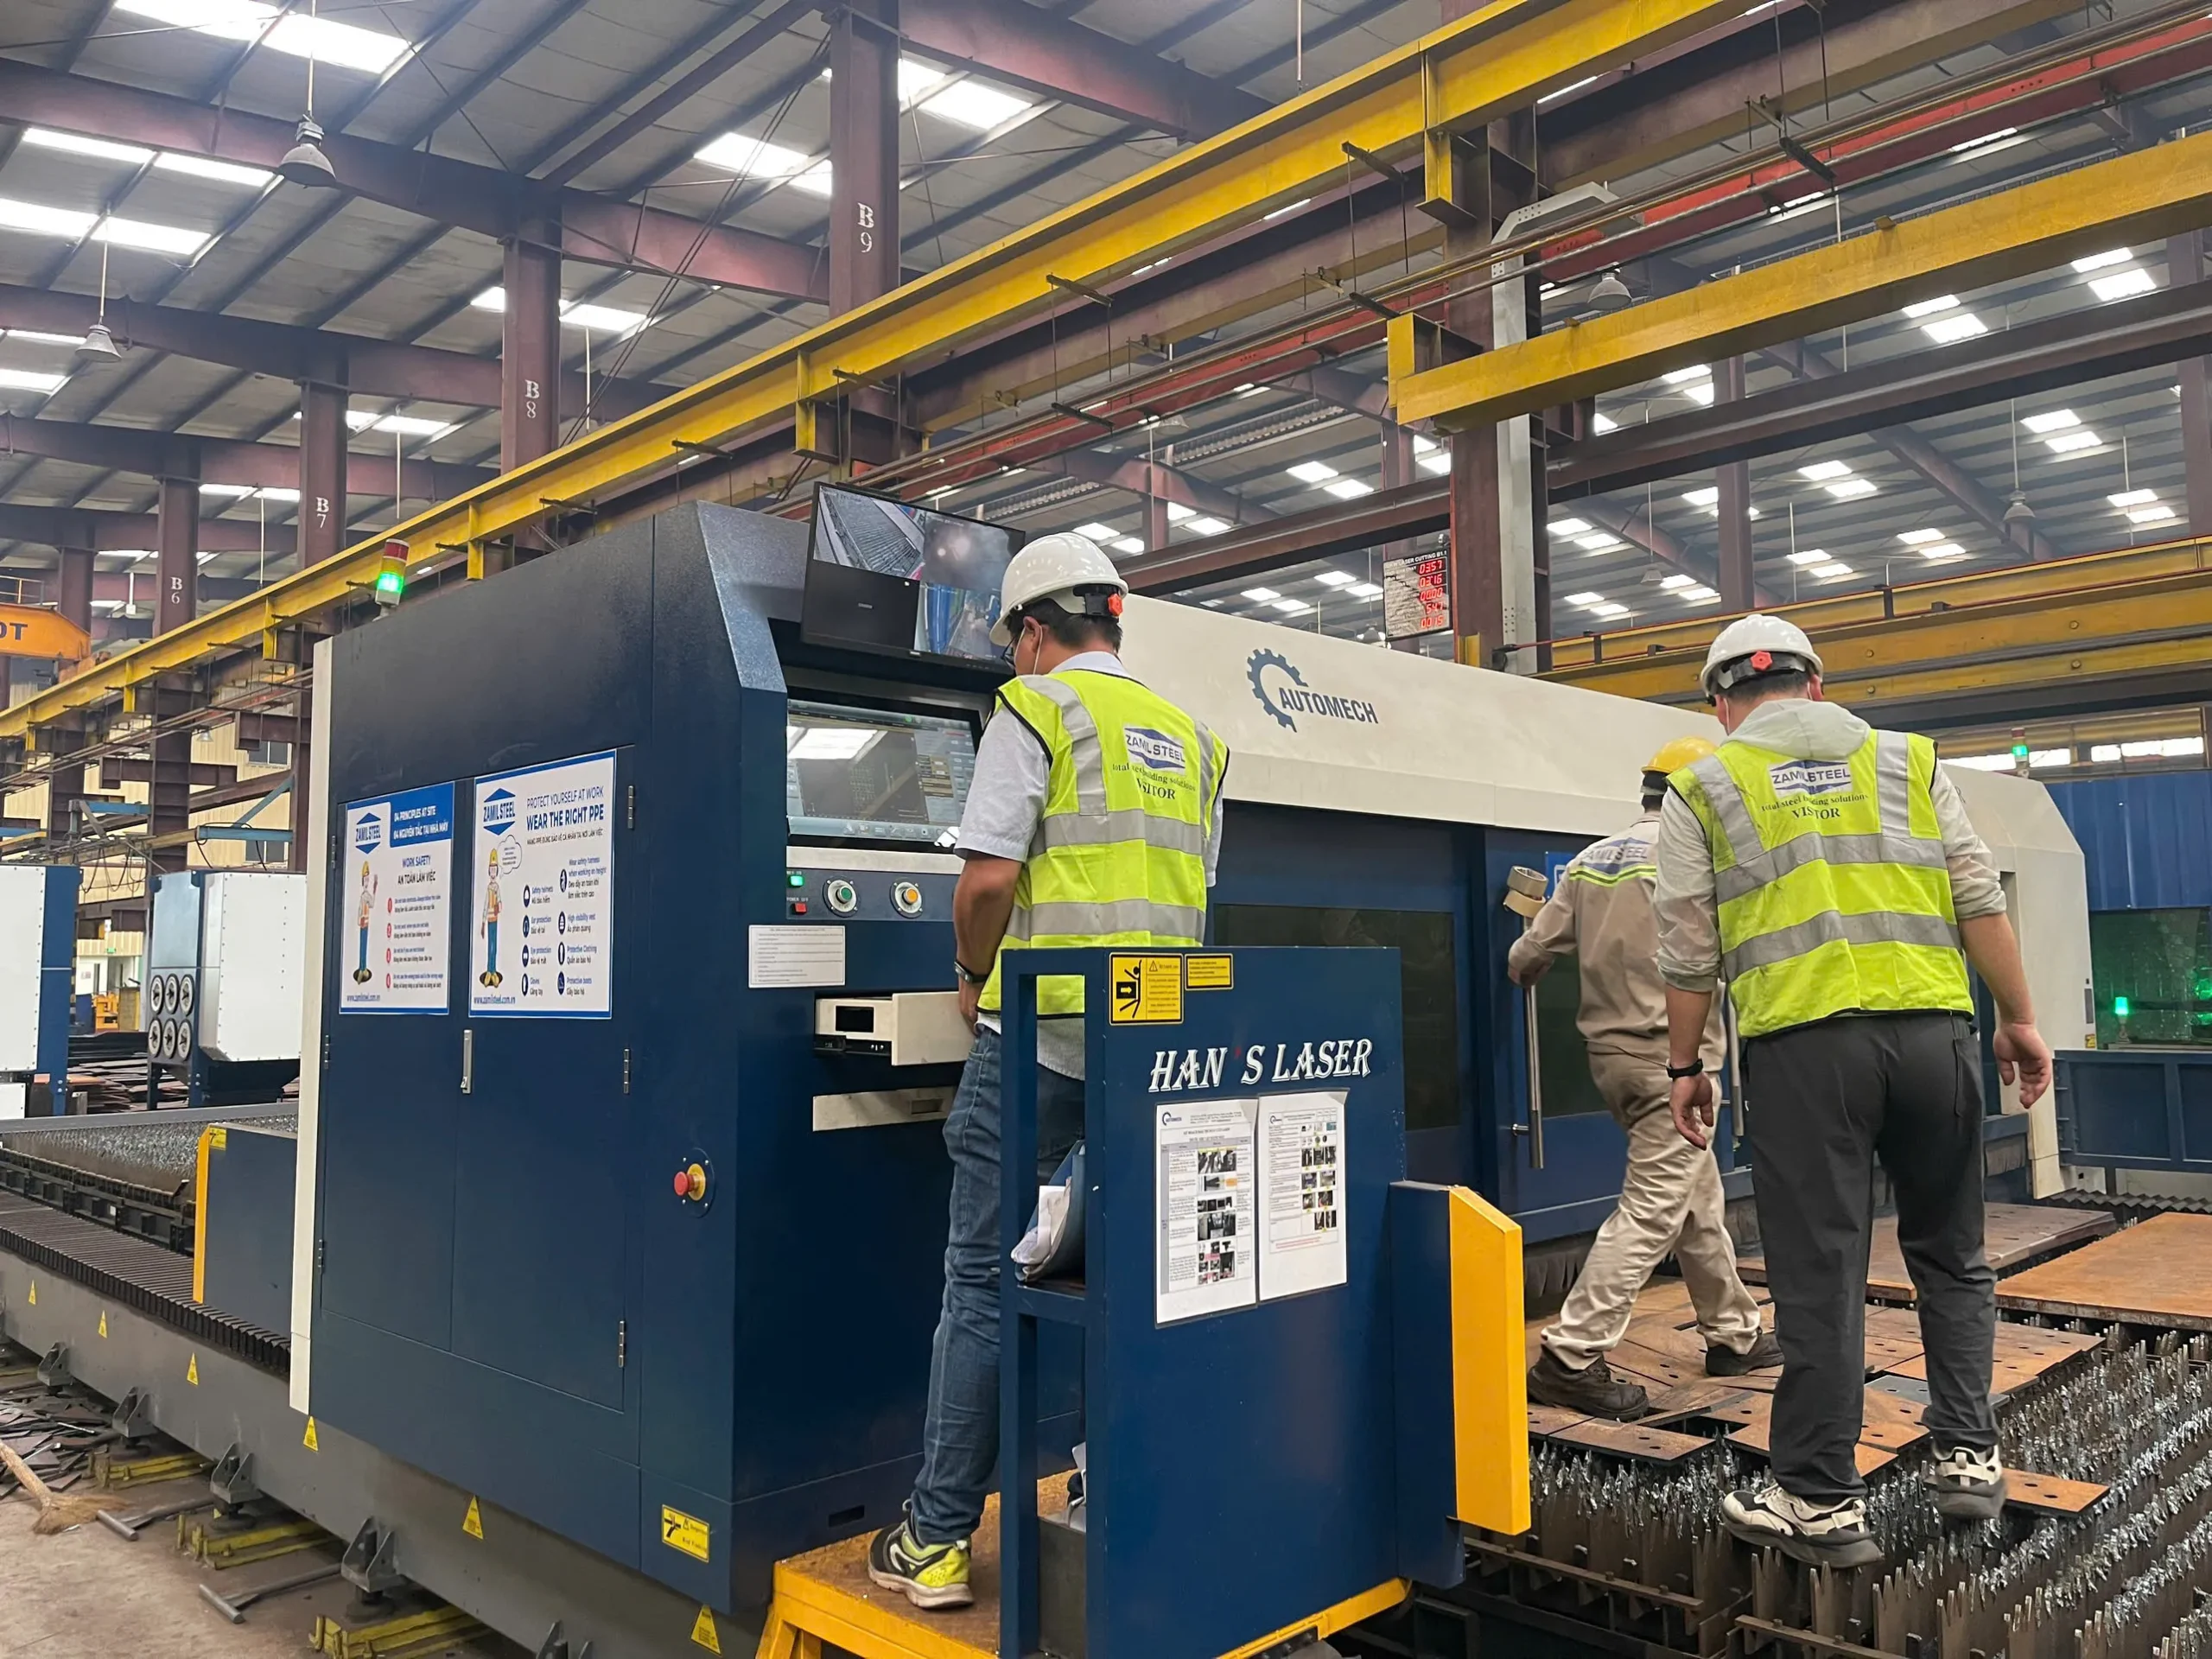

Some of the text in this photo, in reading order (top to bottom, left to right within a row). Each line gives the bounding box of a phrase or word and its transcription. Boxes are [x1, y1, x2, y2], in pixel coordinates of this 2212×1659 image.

[1415, 553, 1436, 563] CUTTING
[1279, 687, 1378, 724] AUTOMECH
[527, 785, 604, 809] PROTECT YOURSELF AT WORK
[1137, 778, 1175, 799] VSITOR
[499, 801, 516, 819] STEEL
[1783, 797, 1802, 808] steel
[399, 808, 422, 821] PRINCIPLES
[526, 804, 604, 831] WEAR THE RIGHT PPE
[1792, 806, 1840, 819] VISTOR
[1614, 847, 1648, 861] SEEL
[1272, 1039, 1373, 1083] LASER
